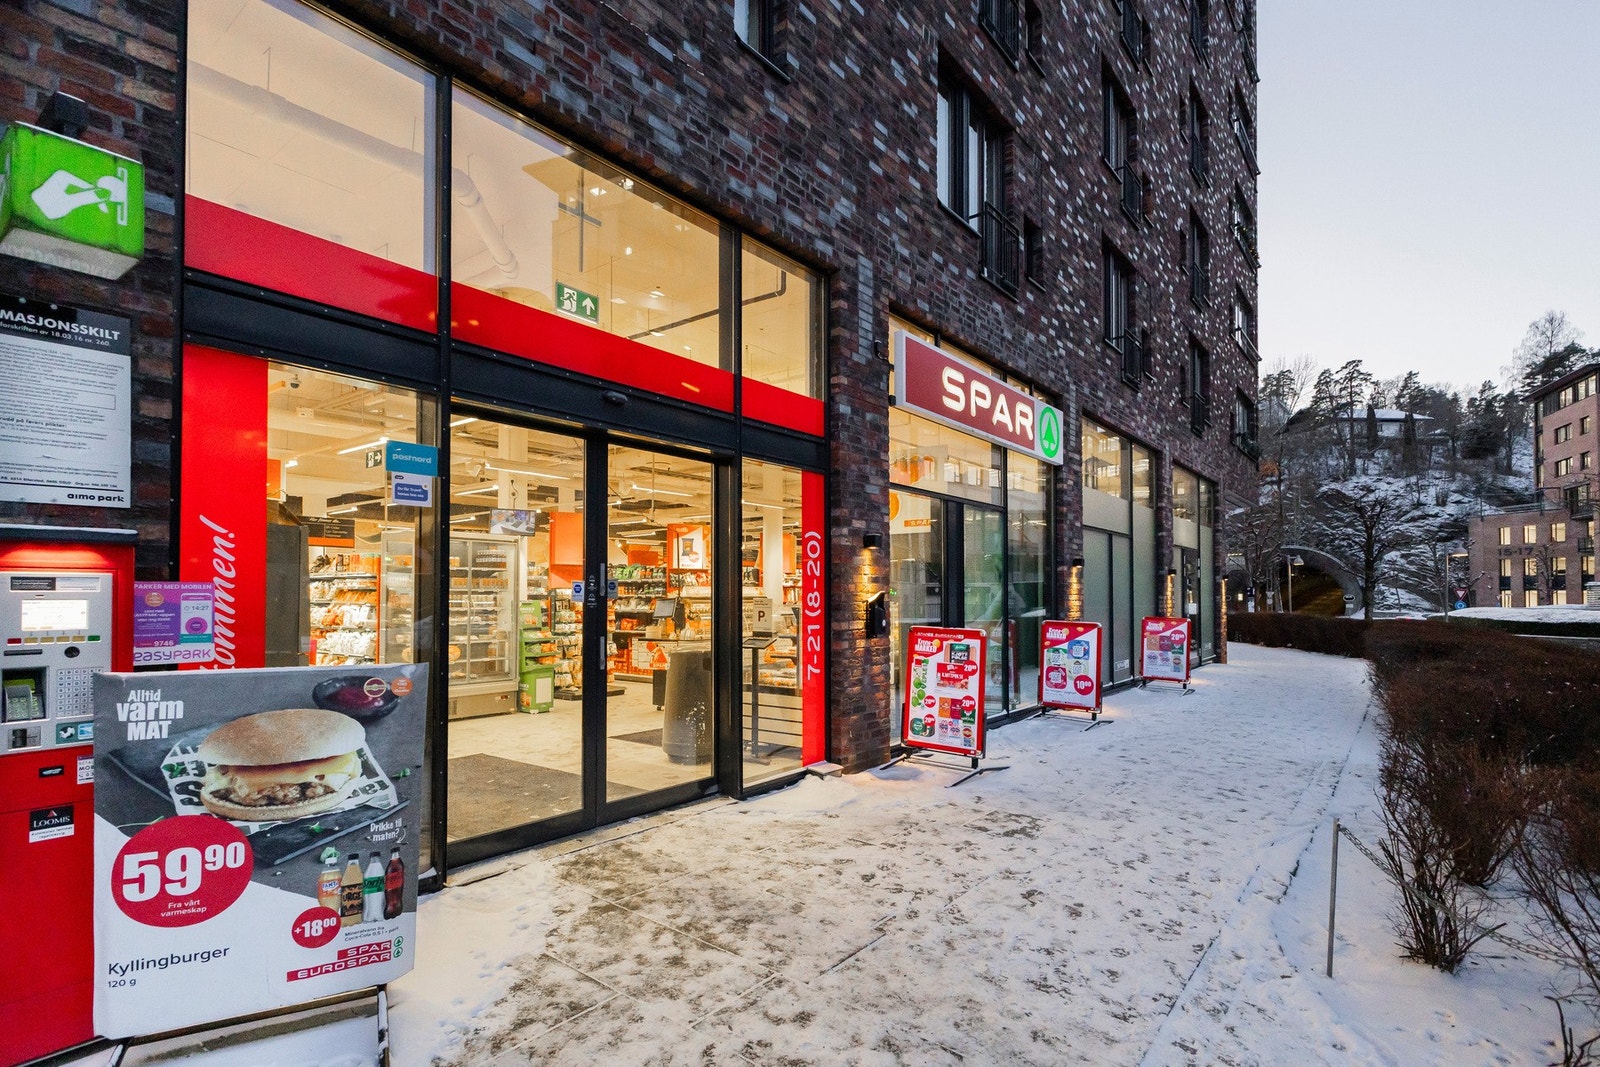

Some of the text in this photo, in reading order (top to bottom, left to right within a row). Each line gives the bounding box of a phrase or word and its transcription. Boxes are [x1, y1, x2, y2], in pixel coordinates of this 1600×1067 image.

[51, 330, 83, 342] 18.03.16
[942, 366, 1033, 440] SPAR
[392, 454, 432, 464] postnord
[98, 494, 124, 502] park
[805, 531, 821, 617] (8-20)
[199, 514, 236, 669] ommen!
[758, 610, 765, 622] P
[807, 624, 821, 680] 7-21
[127, 689, 161, 702] Alltid
[116, 700, 184, 721] varm
[127, 720, 172, 741] MAT
[33, 816, 70, 828] LOOMIS
[370, 820, 394, 832] Drikke
[372, 829, 400, 842] maten?
[342, 891, 362, 901] URGE
[184, 899, 200, 907] vårt
[160, 906, 207, 917] varmeskap
[347, 940, 391, 956] SPAR
[108, 947, 230, 977] Kyllingburger
[297, 952, 391, 979] EUROSPAR
[108, 979, 126, 988] 120
